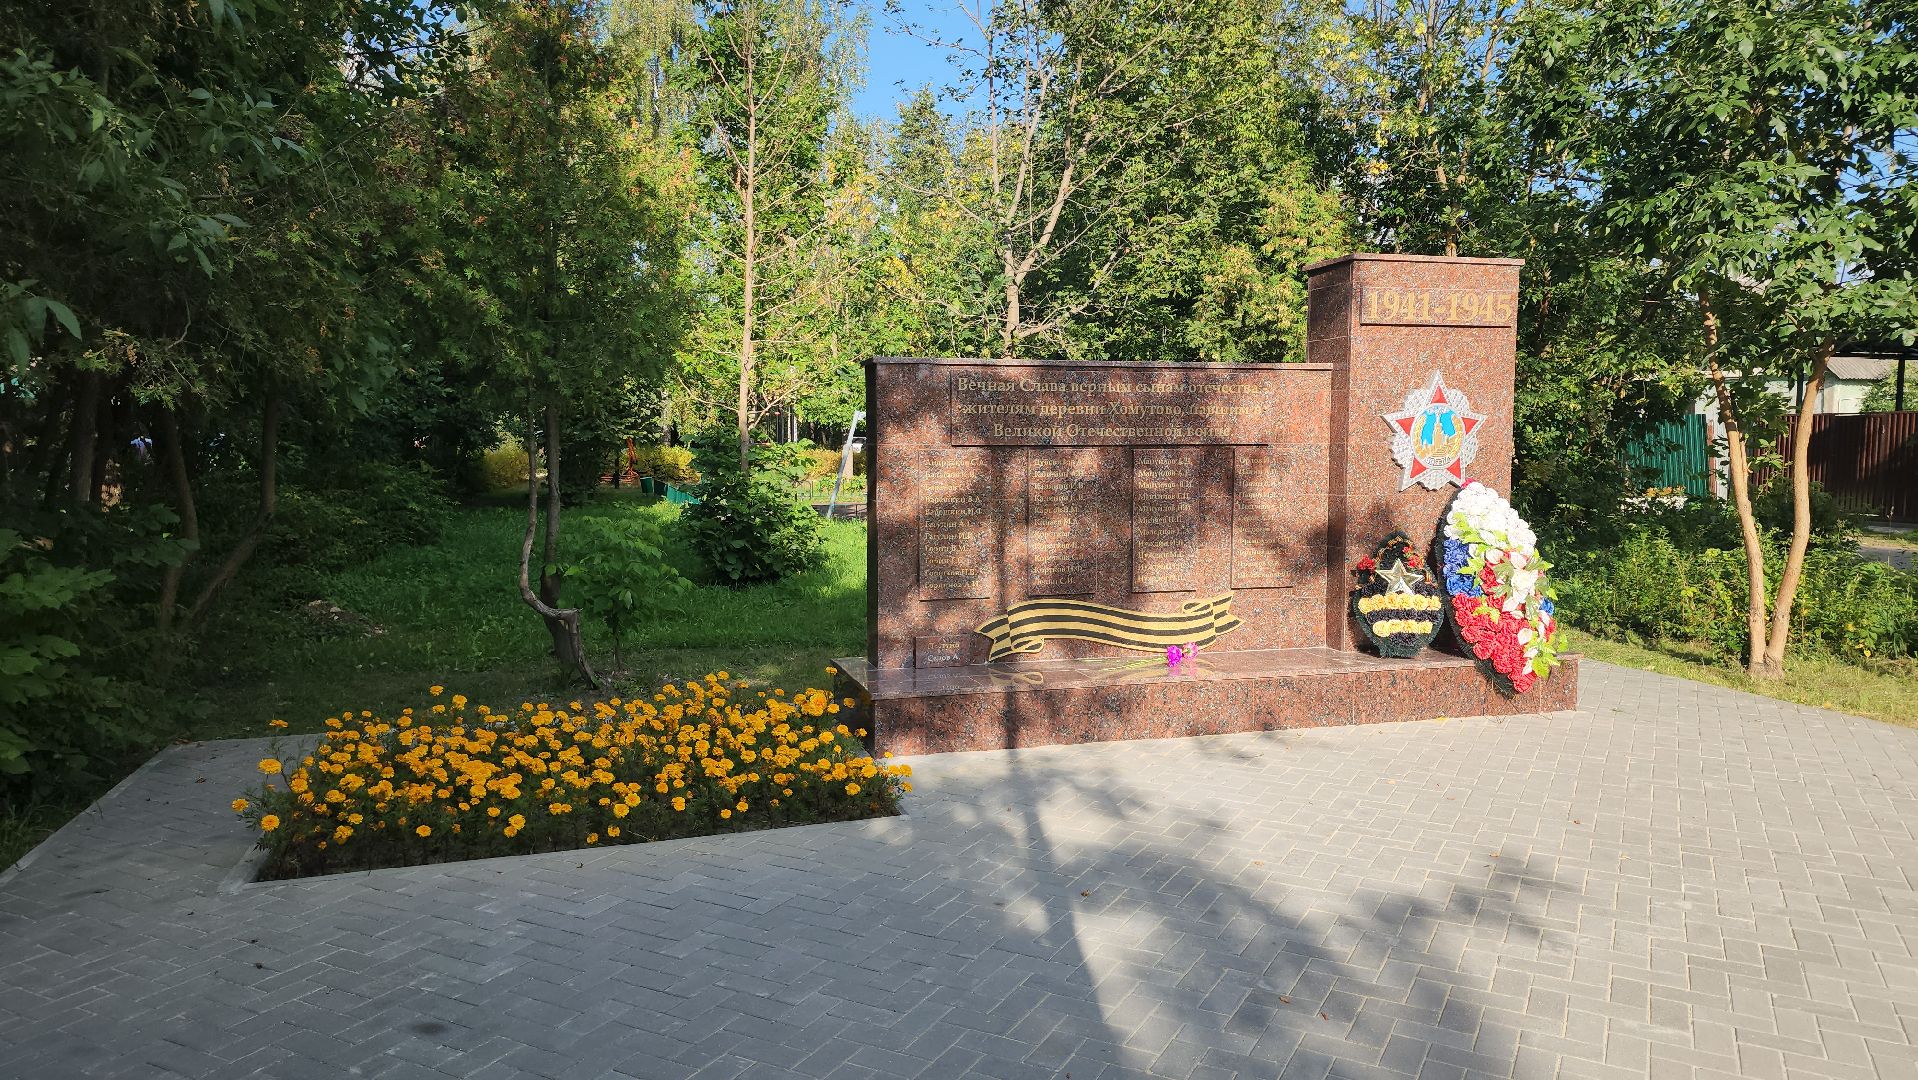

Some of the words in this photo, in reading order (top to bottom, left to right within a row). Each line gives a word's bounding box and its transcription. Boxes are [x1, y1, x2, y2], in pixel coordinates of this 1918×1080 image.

[1366, 290, 1511, 322] 1941-1945
[957, 378, 1015, 392] Вечная
[1019, 378, 1066, 392] Слава
[1071, 383, 1131, 396] верным
[1136, 383, 1185, 393] сынам
[1040, 404, 1104, 418] деревни
[994, 423, 1062, 437] Великой
[1066, 424, 1182, 437] Отечественной
